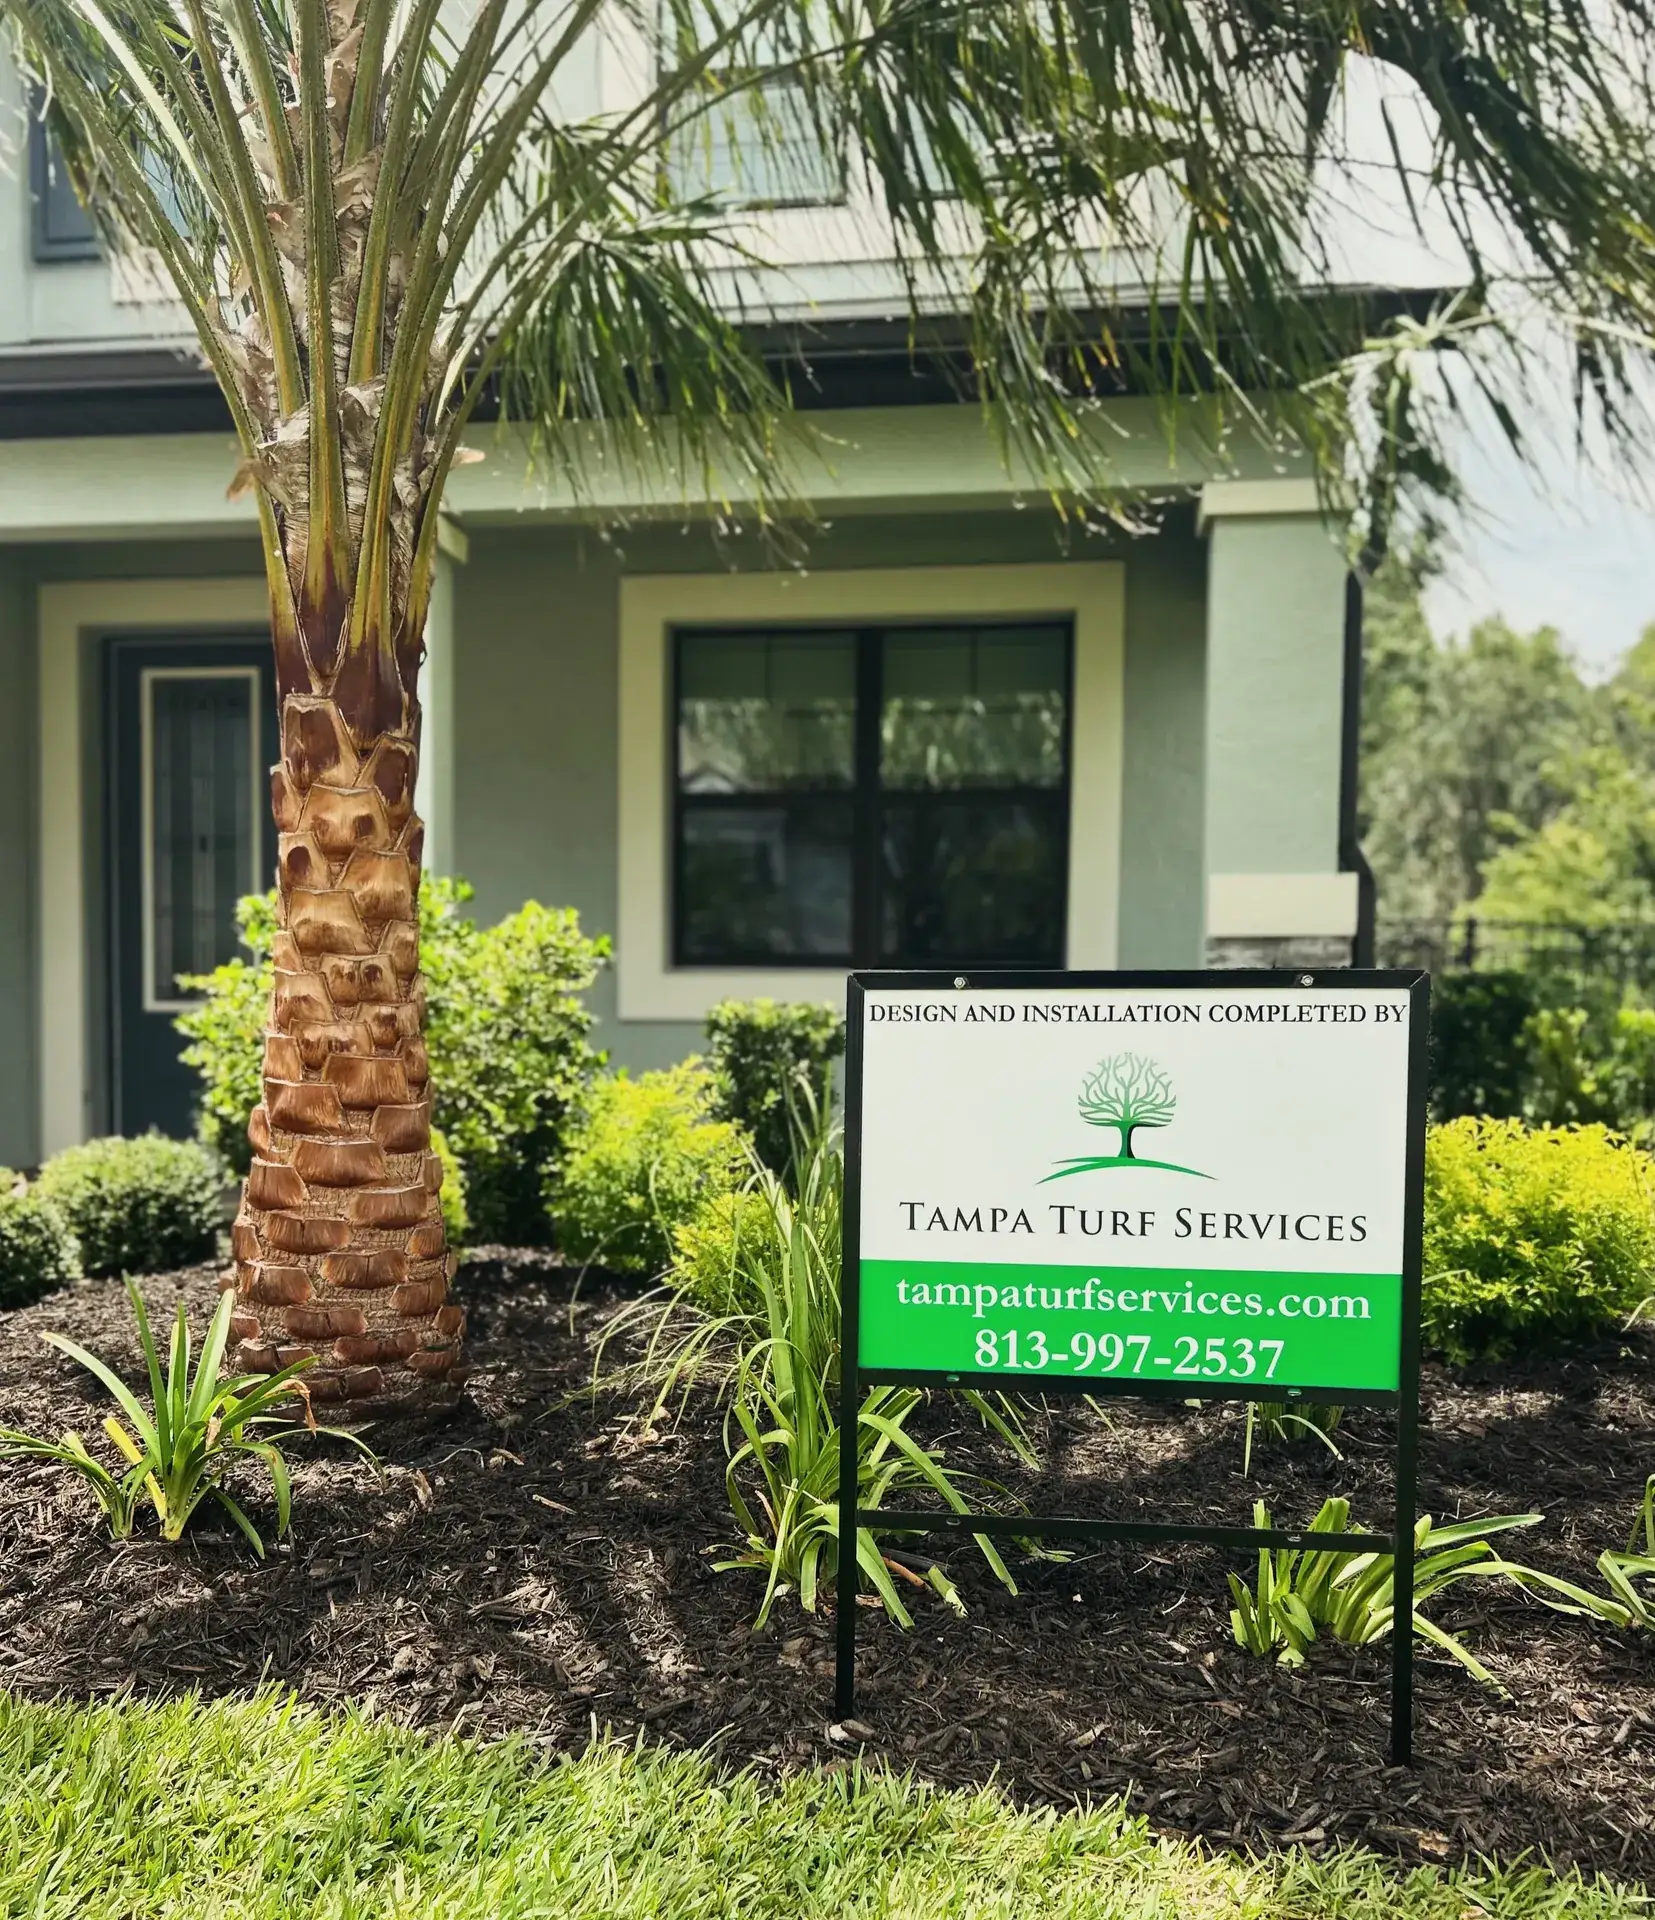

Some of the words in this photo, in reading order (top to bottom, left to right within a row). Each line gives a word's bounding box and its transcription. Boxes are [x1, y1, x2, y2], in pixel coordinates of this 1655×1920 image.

[869, 1004, 958, 1023] DESIGN
[963, 1004, 1016, 1023] AND
[1022, 1004, 1202, 1023] INSTALLATION
[1208, 1004, 1367, 1023] COMPLETED
[1373, 1004, 1408, 1023] BY
[896, 1277, 1371, 1319] tampaturfservices.com
[974, 1329, 1285, 1379] 813-997-2537
